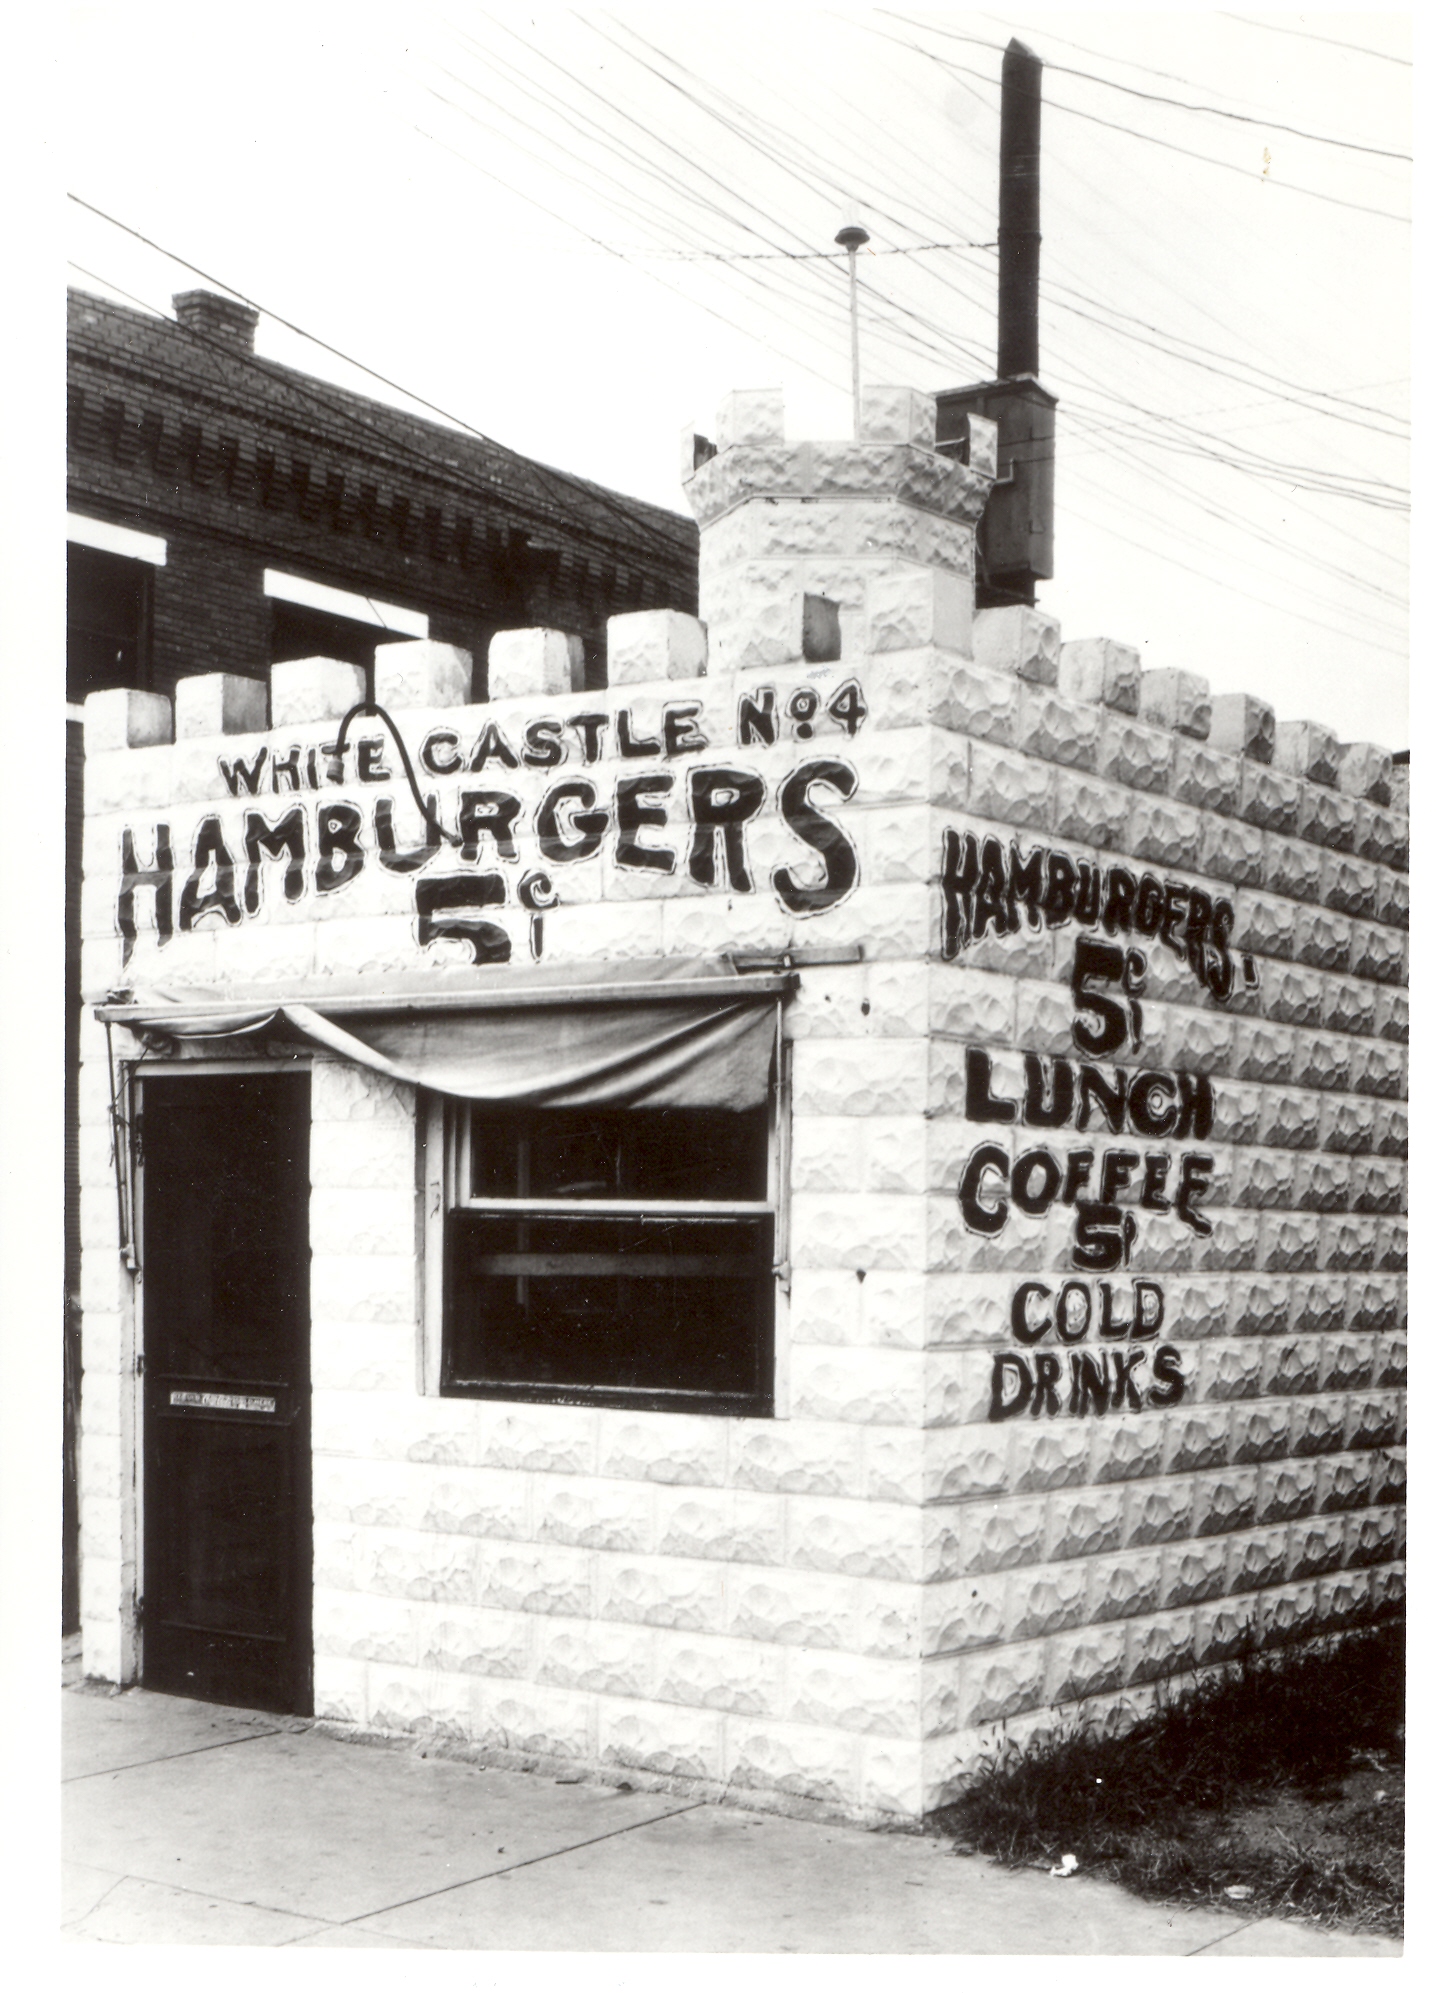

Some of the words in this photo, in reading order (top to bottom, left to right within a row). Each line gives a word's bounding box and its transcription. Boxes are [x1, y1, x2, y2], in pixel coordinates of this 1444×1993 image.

[219, 733, 392, 798] WHITE
[422, 700, 708, 777] CASTLE
[116, 755, 862, 970] HAMBURGERS
[965, 1045, 1215, 1141] LUNCH
[959, 1140, 1214, 1239] COFFEE
[1011, 1278, 1165, 1345] COLD
[987, 1345, 1187, 1422] DRINKS
